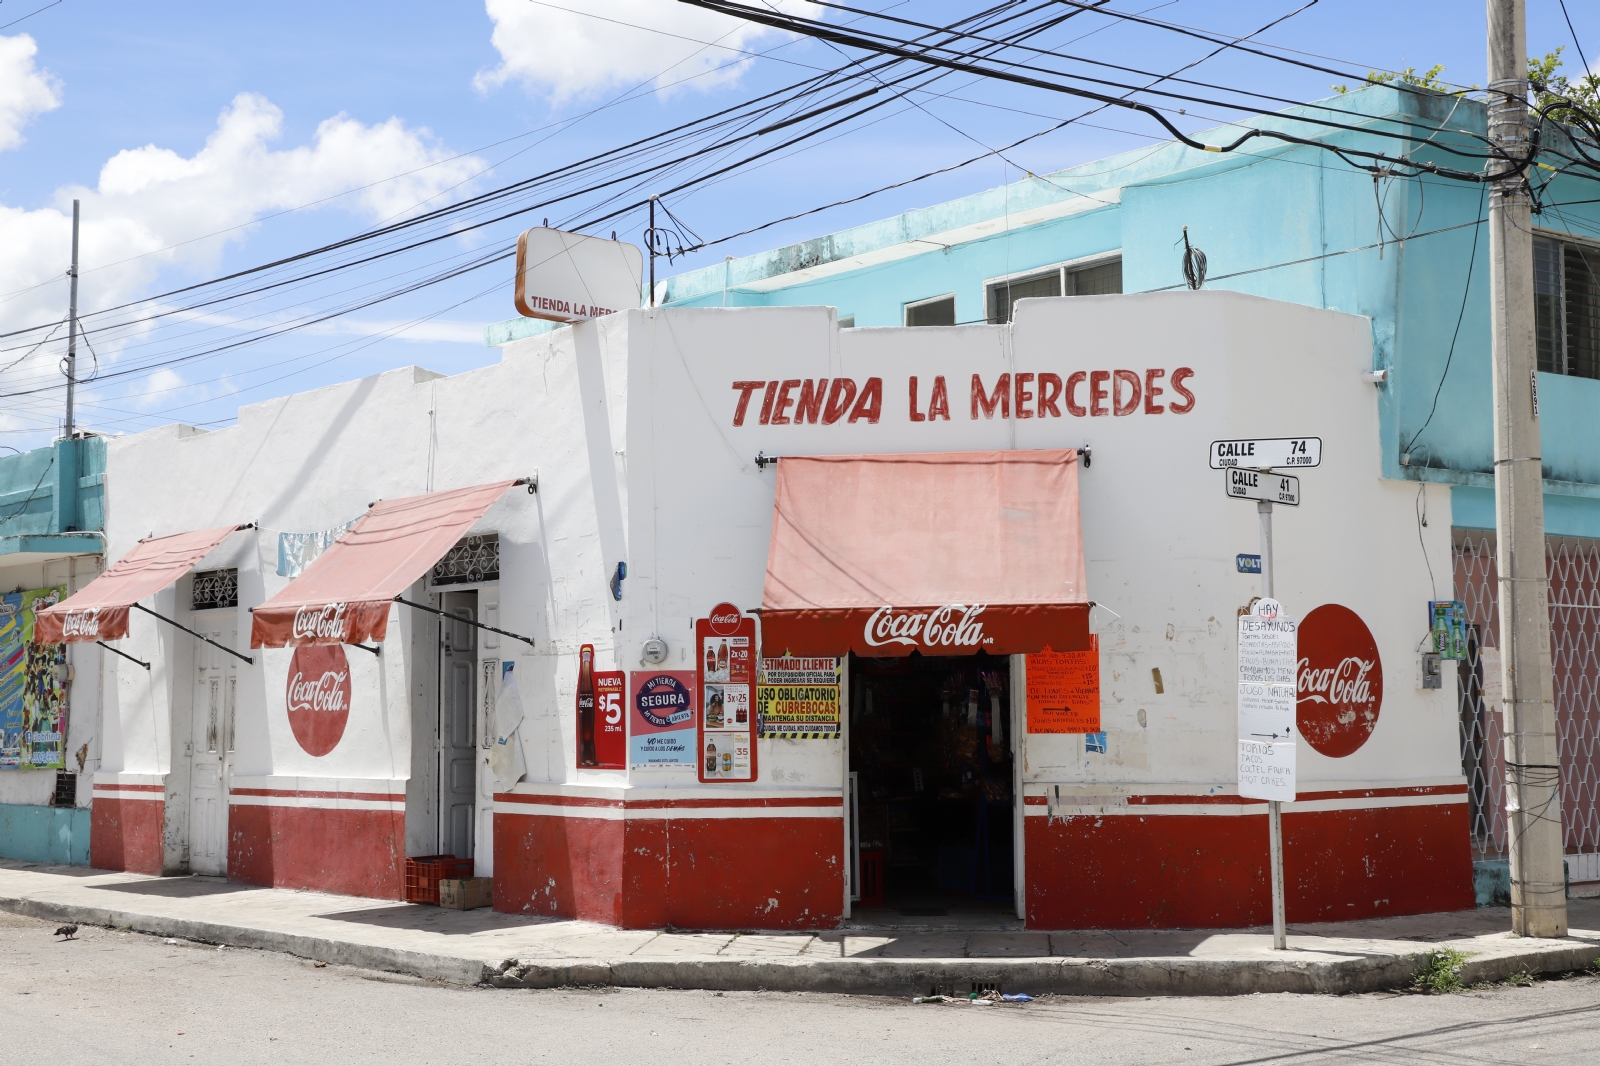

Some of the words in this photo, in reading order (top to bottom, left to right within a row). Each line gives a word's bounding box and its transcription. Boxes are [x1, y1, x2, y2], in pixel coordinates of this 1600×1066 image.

[531, 296, 570, 313] TIENDA
[574, 303, 586, 316] LA
[731, 376, 882, 427] TIENDA
[909, 375, 951, 421] LA
[970, 367, 1196, 421] MERCEDES
[1218, 443, 1255, 457] CALLE
[1291, 440, 1306, 455] 74
[1219, 458, 1238, 467] CIUDAD
[1232, 470, 1258, 487] CALLE
[1280, 478, 1290, 492] 41
[1233, 486, 1246, 495] CIUDAD
[1258, 604, 1279, 617] HAY
[63, 607, 101, 637] Coca-Cola
[293, 602, 348, 639] Coca-Cola
[712, 613, 740, 623] Coca-Cola
[863, 603, 988, 647] Coca-Cola
[1242, 620, 1296, 633] DESAYUNOS
[762, 659, 800, 671] STIMADO
[802, 659, 833, 670] CLIENTE
[598, 678, 622, 686] NUEVA
[656, 677, 677, 688] TIENDA
[288, 671, 348, 711] Coca-Cola
[757, 687, 775, 700] USO
[778, 687, 836, 700] OBLIGATORIO
[1240, 684, 1263, 696] JUGO
[641, 693, 685, 707] SEGURA
[598, 693, 622, 724] $5
[757, 701, 769, 714] DE
[775, 701, 836, 715] CUBREBOCAS
[1240, 764, 1265, 774] COCTEL
